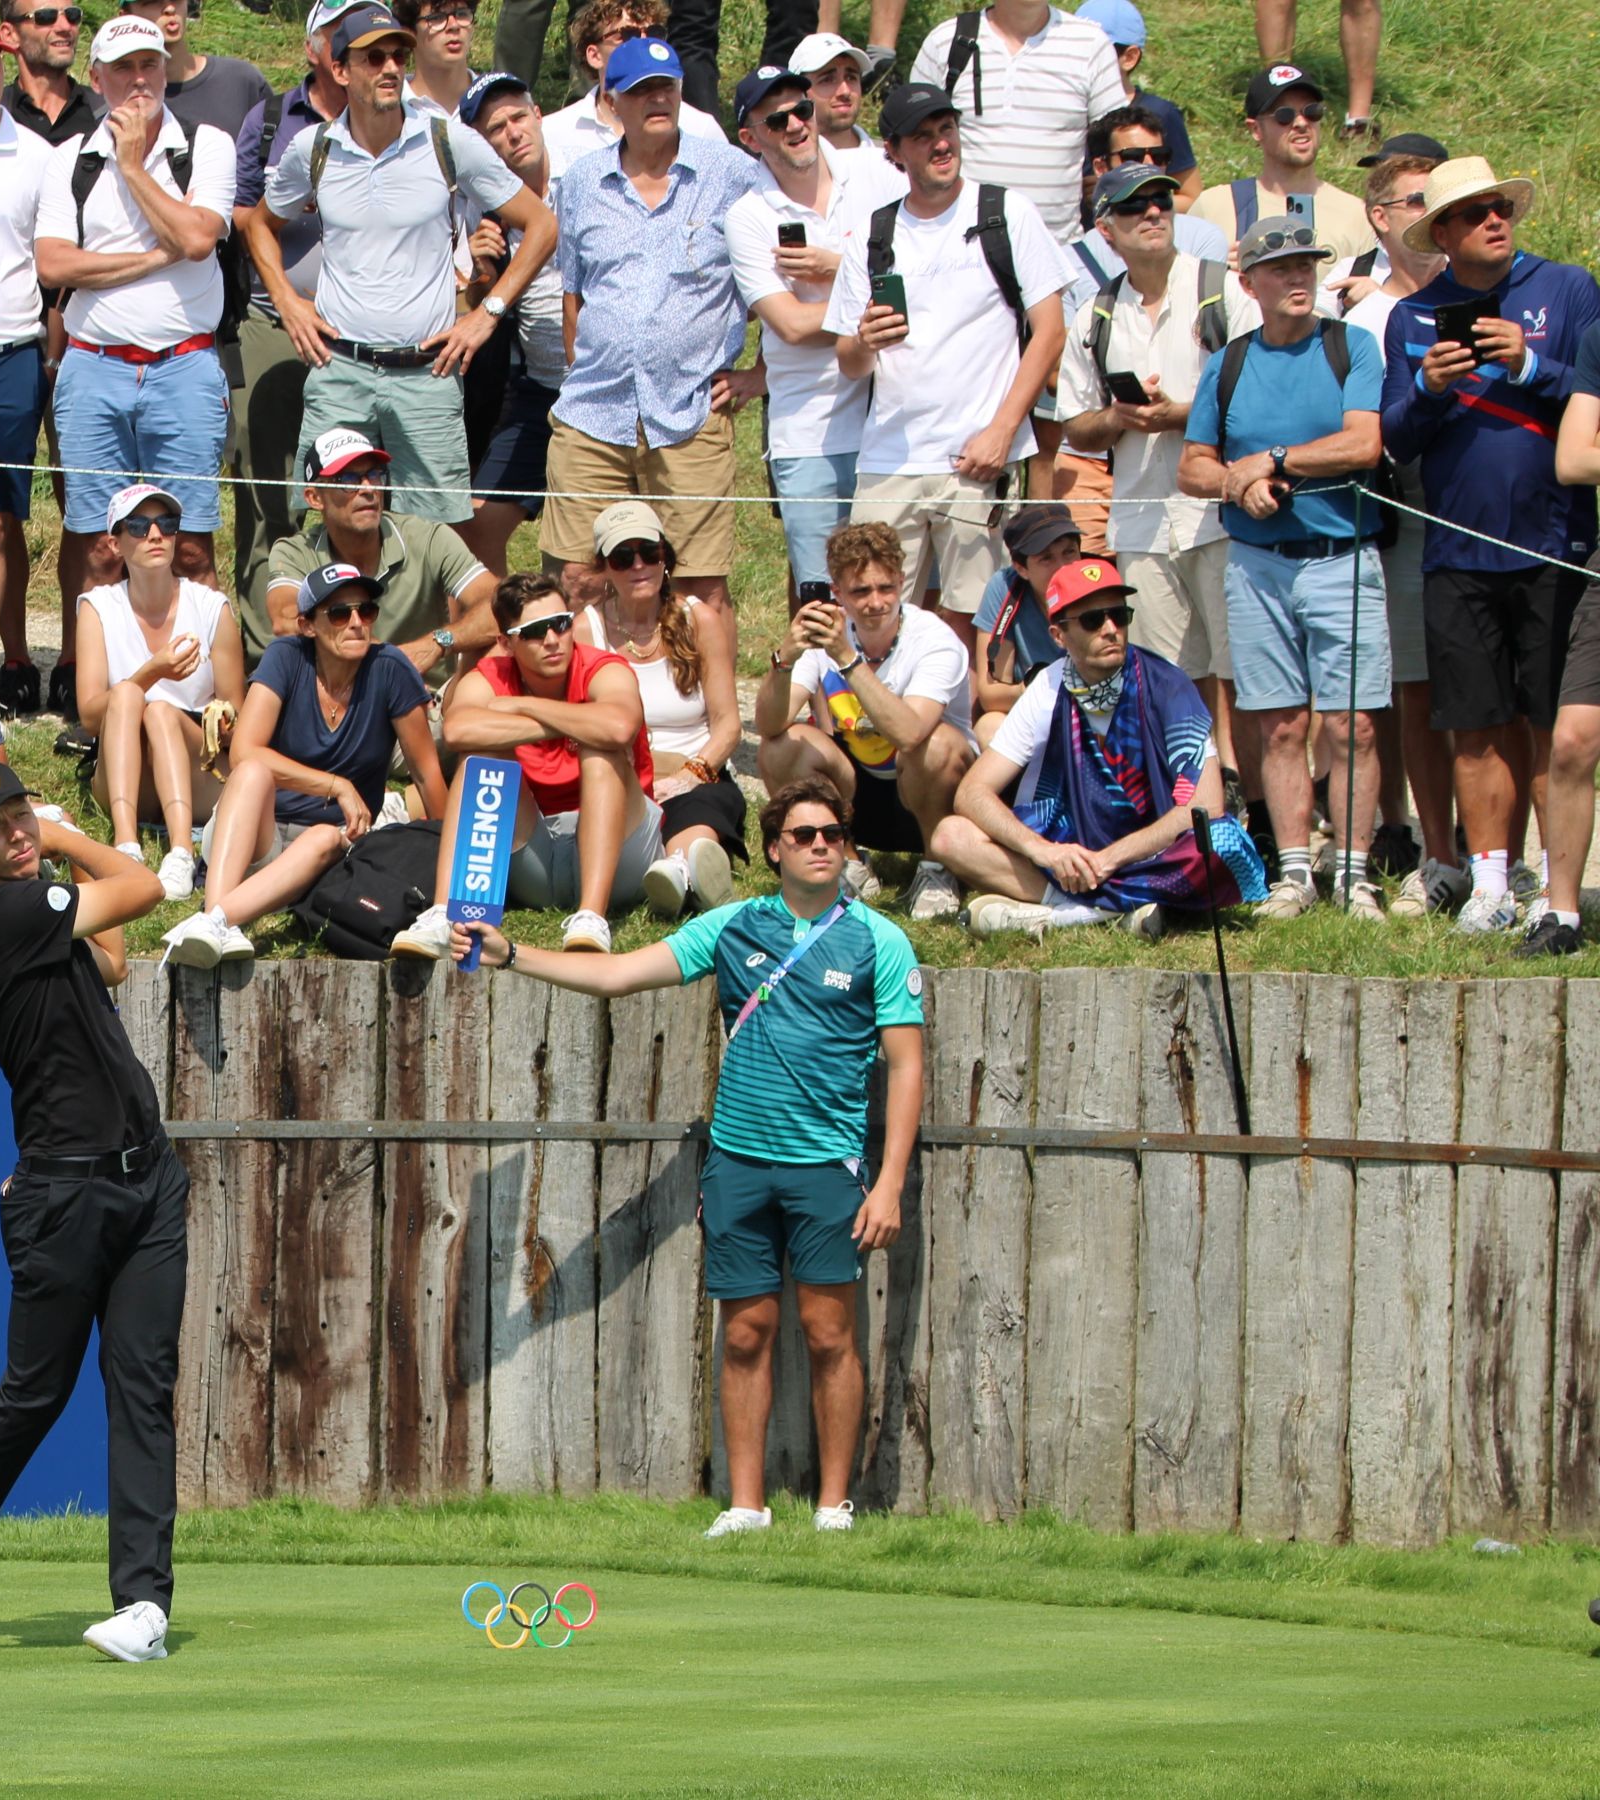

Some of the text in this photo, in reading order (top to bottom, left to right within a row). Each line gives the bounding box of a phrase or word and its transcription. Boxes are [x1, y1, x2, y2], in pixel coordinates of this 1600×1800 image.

[106, 23, 159, 41] Titleist
[465, 769, 505, 892] SILENCE
[823, 977, 851, 992] 2024
[825, 969, 853, 984] PARIS
